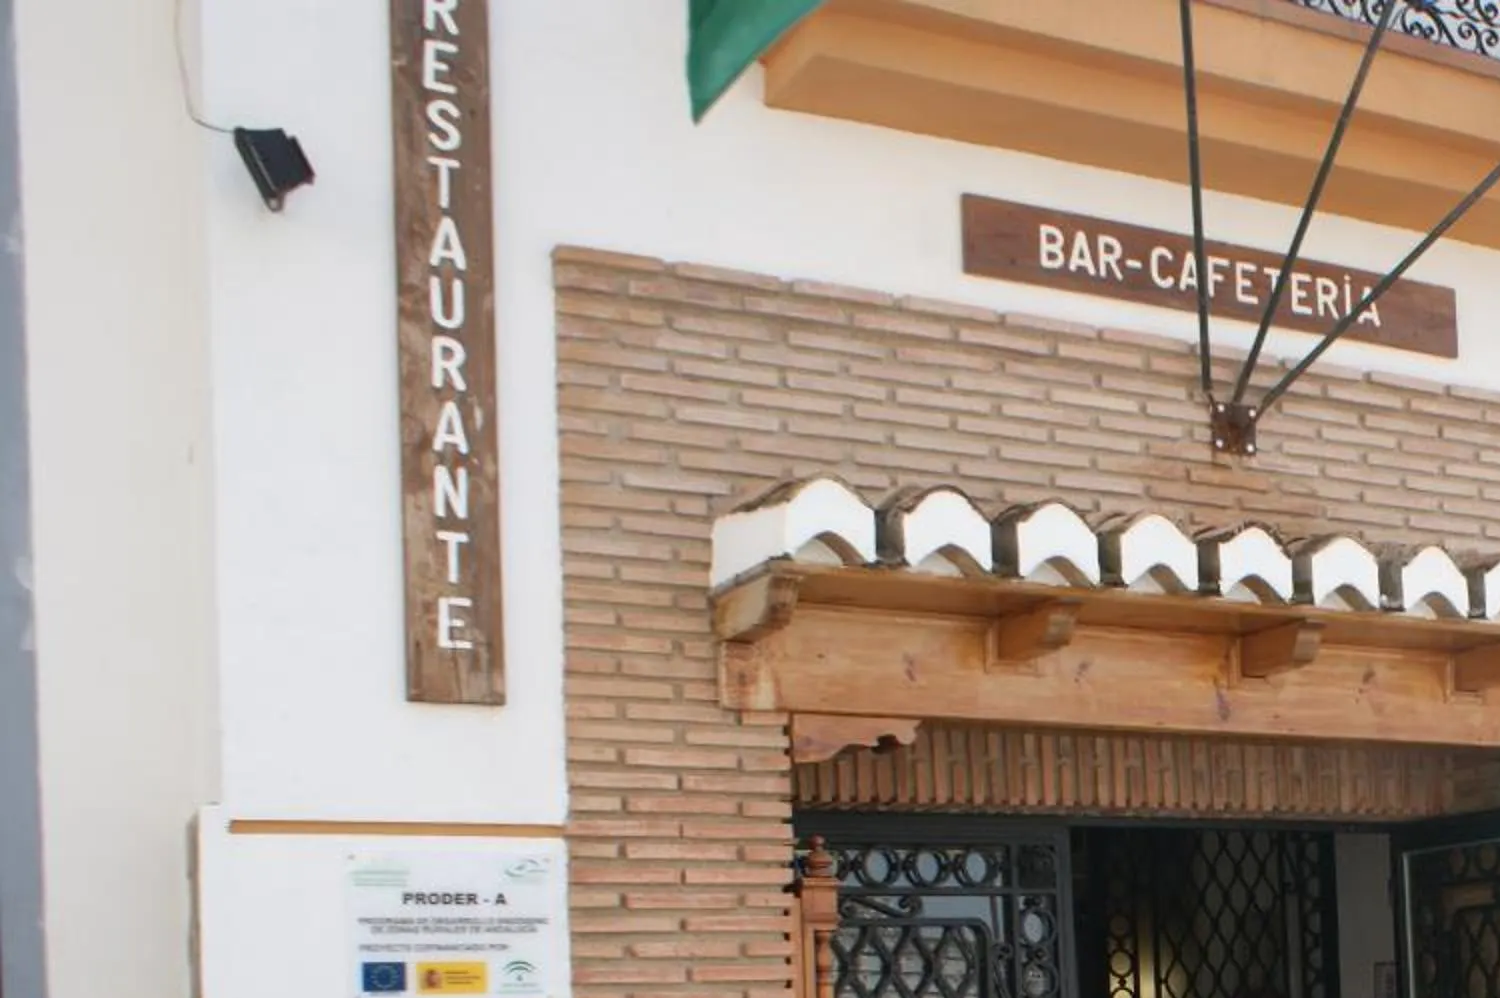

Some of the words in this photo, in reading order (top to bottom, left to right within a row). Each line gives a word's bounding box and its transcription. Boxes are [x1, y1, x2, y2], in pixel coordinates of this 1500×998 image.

[422, 0, 473, 650] RESTAURANTE
[402, 892, 479, 905] PRODER
[495, 892, 508, 905] A
